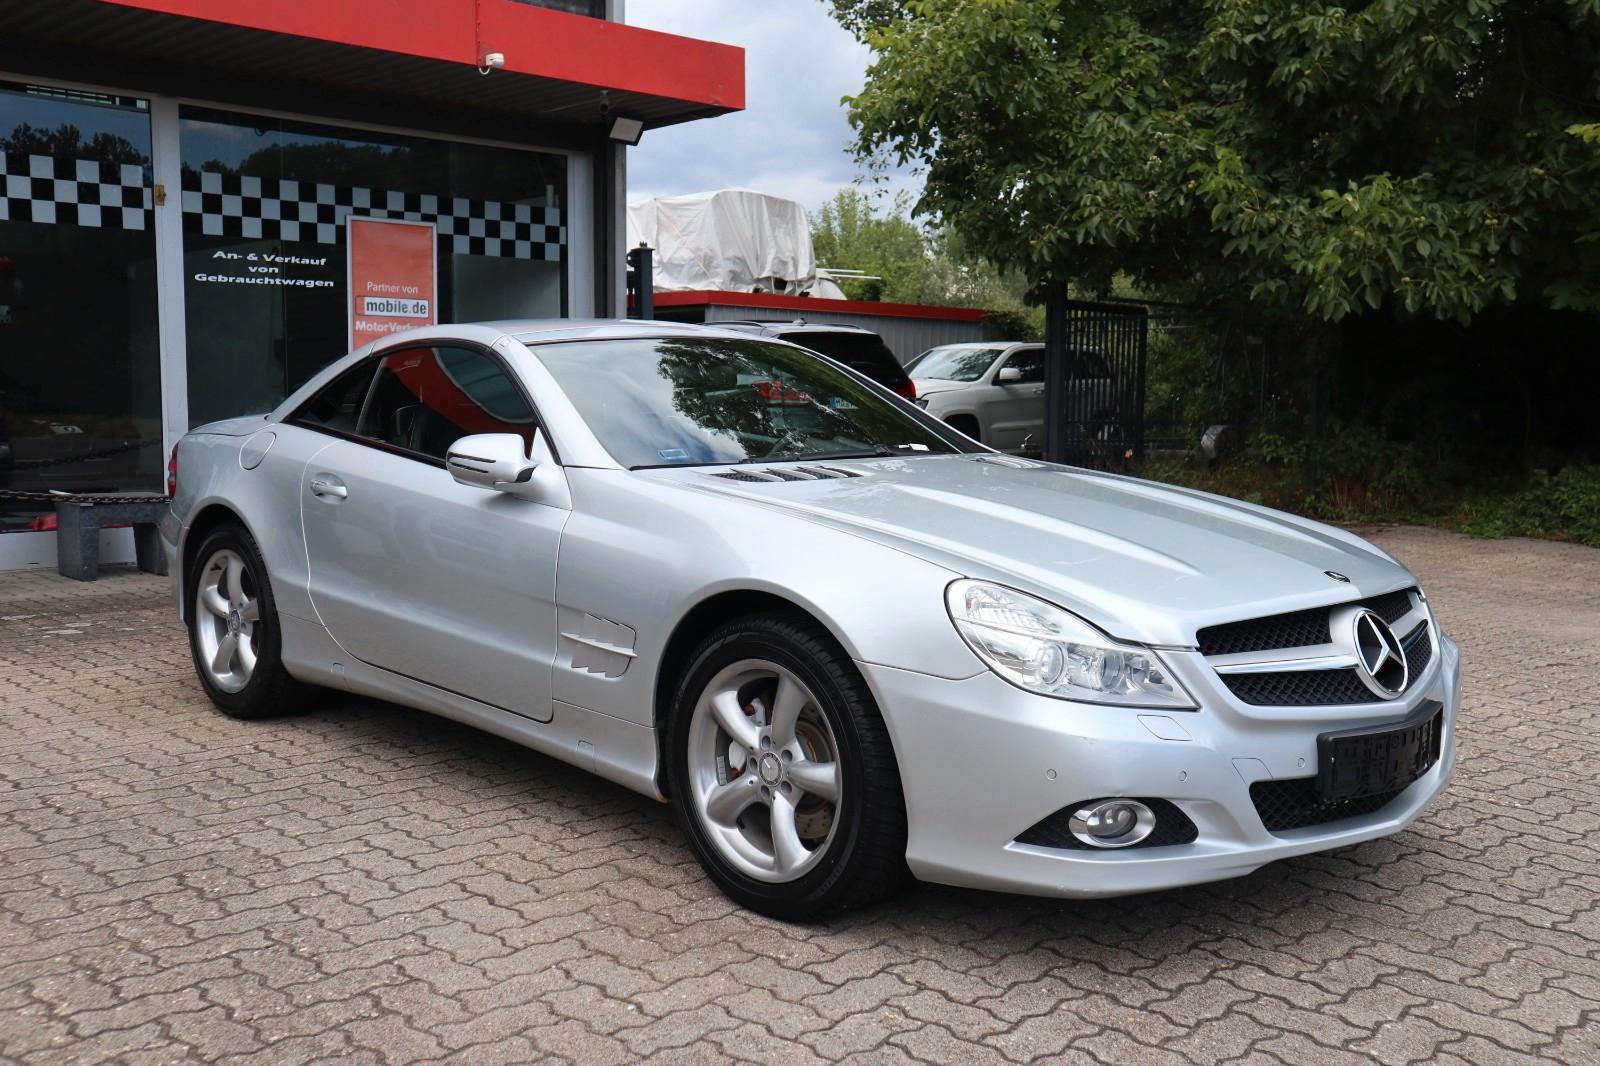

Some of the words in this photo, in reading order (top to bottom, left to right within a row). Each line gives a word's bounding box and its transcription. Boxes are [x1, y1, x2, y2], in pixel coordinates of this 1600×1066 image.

[212, 250, 243, 260] An-
[247, 253, 258, 261] &
[262, 254, 327, 266] Verkauf
[194, 273, 334, 288] Gebrauchtwagen
[367, 281, 400, 293] Partner
[402, 285, 419, 294] von
[366, 299, 427, 315] mobile.de
